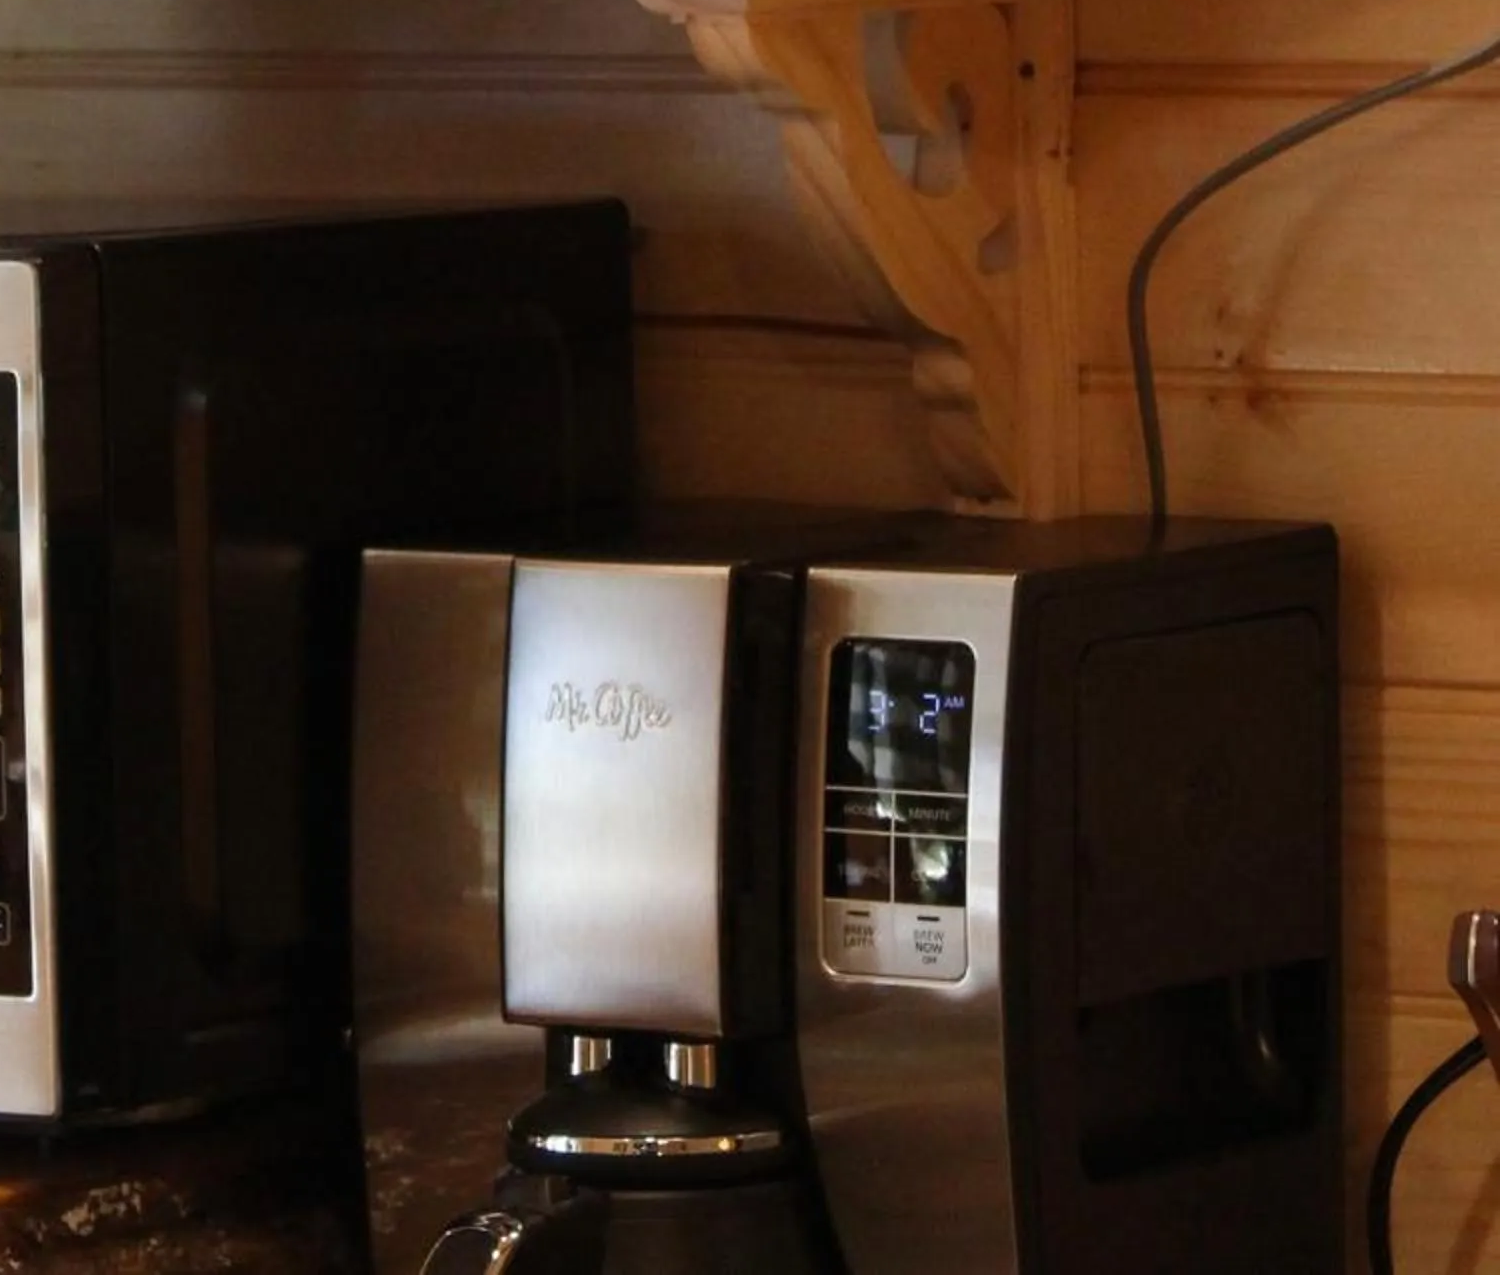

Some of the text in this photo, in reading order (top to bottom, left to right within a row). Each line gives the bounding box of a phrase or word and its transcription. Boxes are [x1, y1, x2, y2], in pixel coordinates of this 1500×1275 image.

[943, 694, 965, 709] AM
[594, 680, 673, 743] Coffee
[908, 807, 951, 822] MINUTE
[914, 942, 944, 955] NOW
